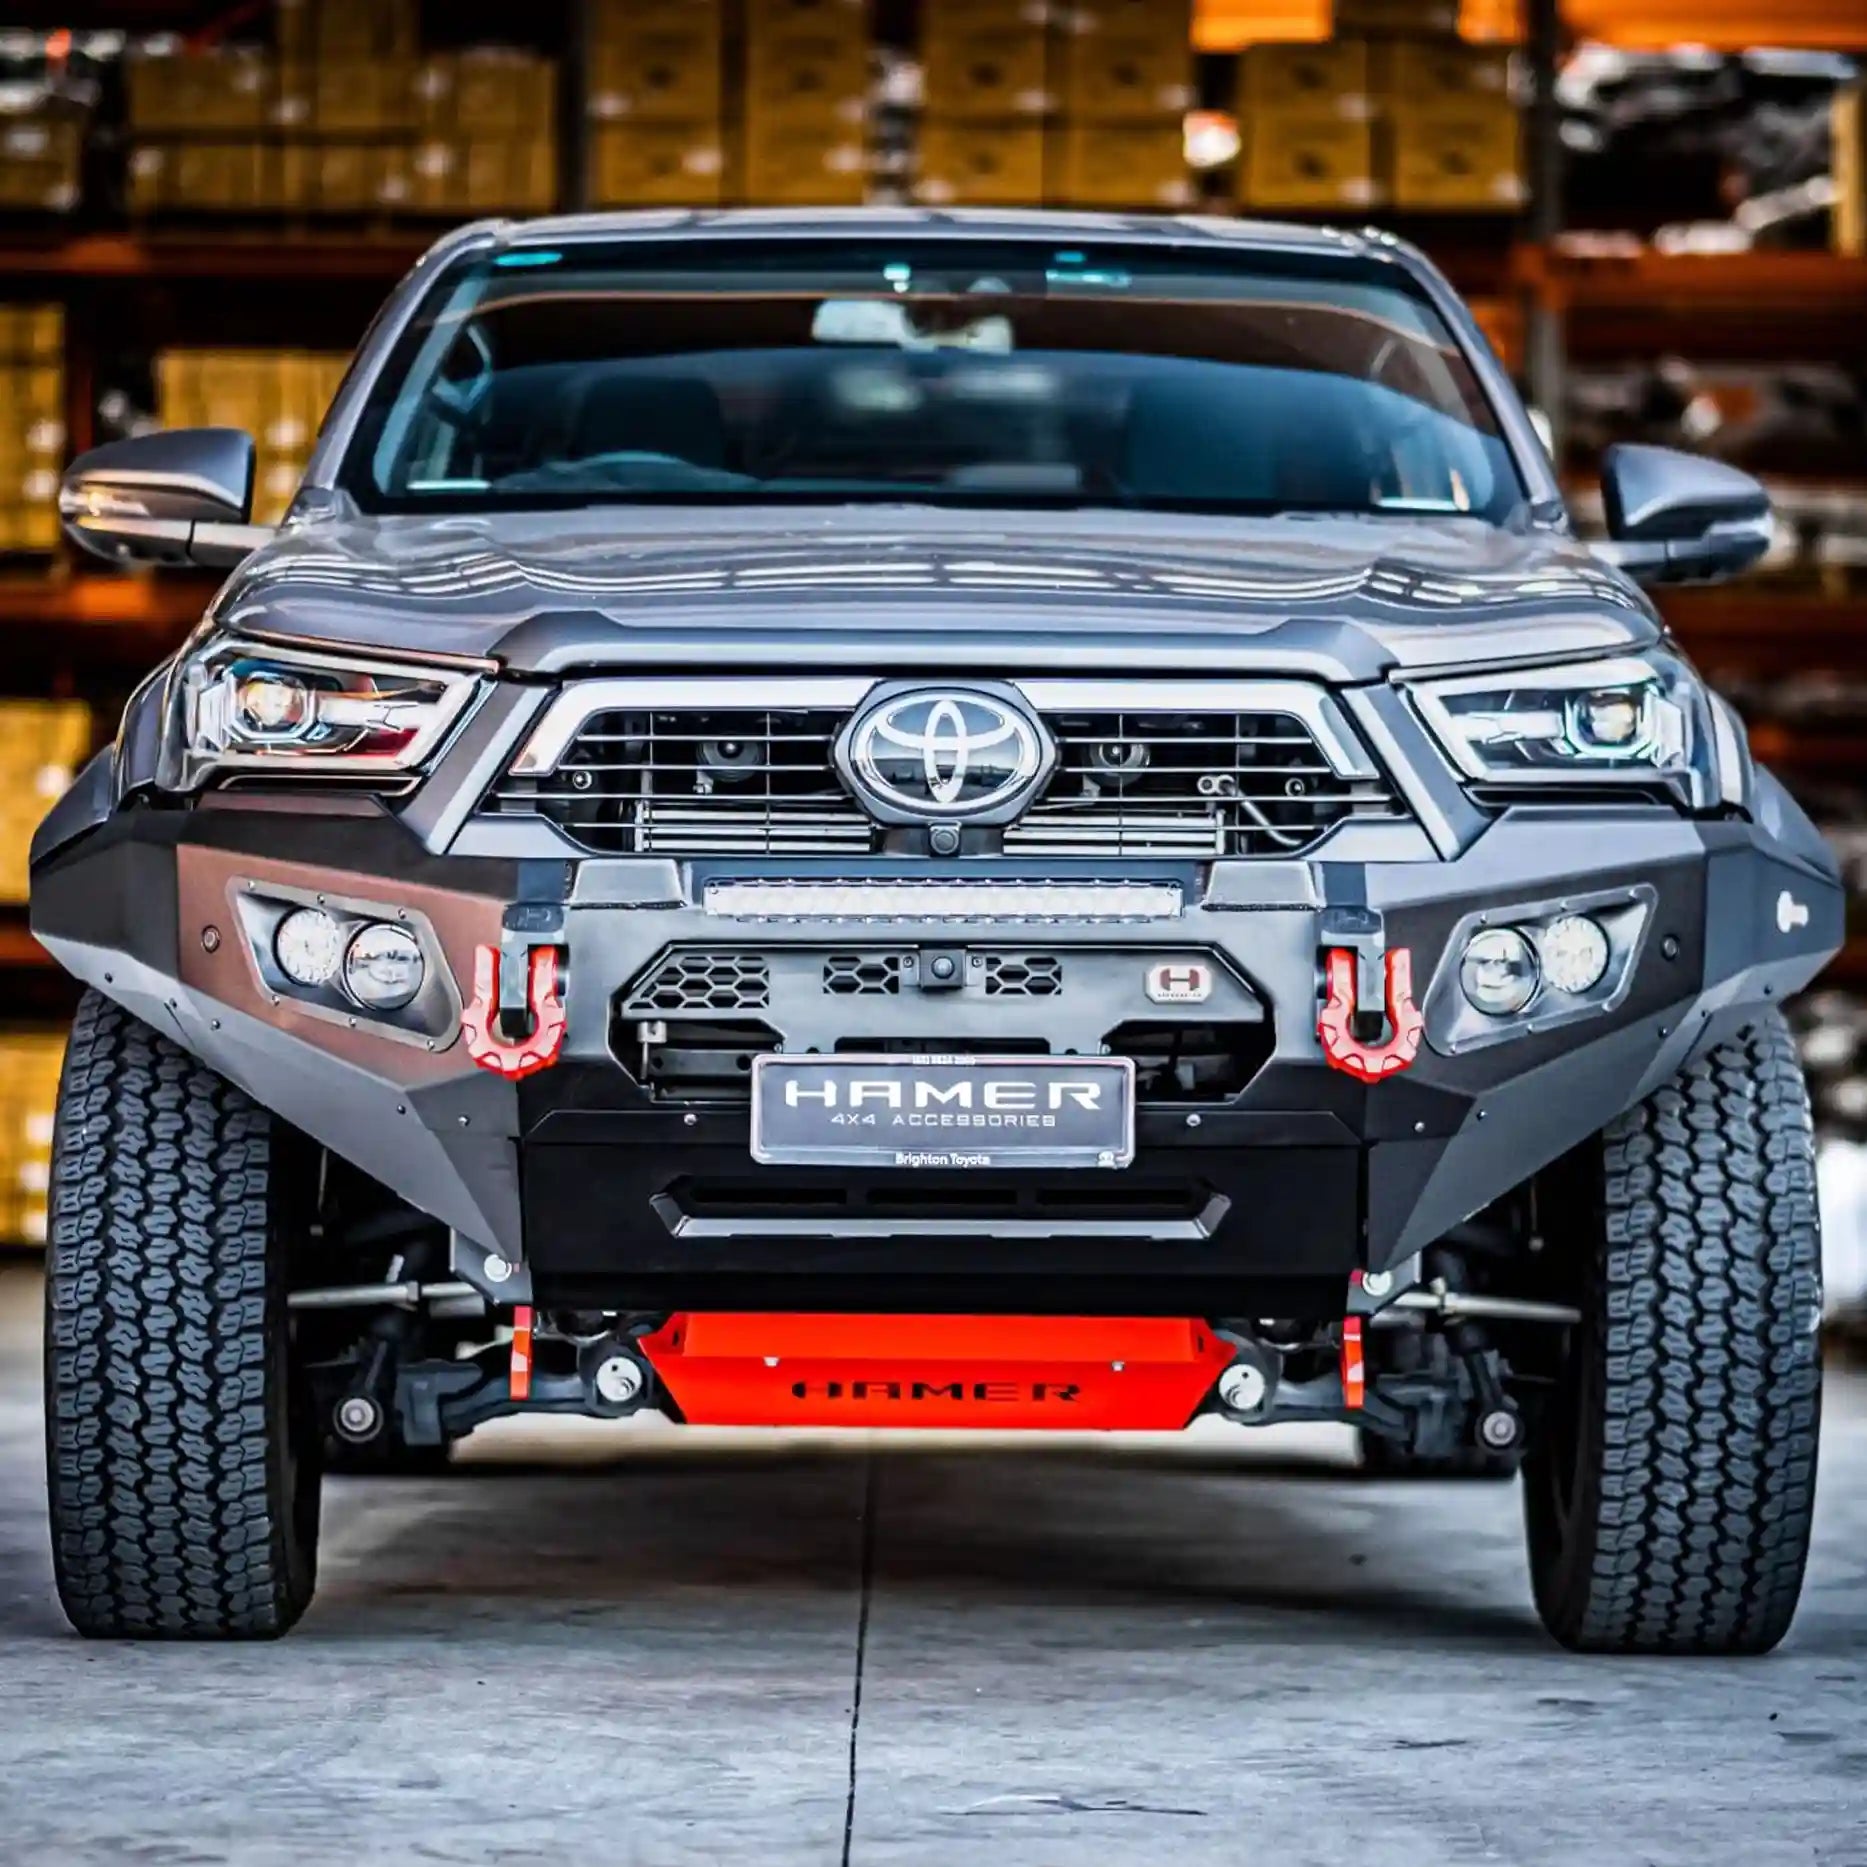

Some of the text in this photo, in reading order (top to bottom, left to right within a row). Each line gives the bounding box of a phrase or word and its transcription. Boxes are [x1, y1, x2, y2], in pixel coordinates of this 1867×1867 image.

[785, 1080, 1102, 1110] HAMER
[893, 1114, 1056, 1127] ACCESSORIES
[895, 1152, 991, 1167] Brighton Toyota
[792, 1381, 1081, 1403] HAMER
